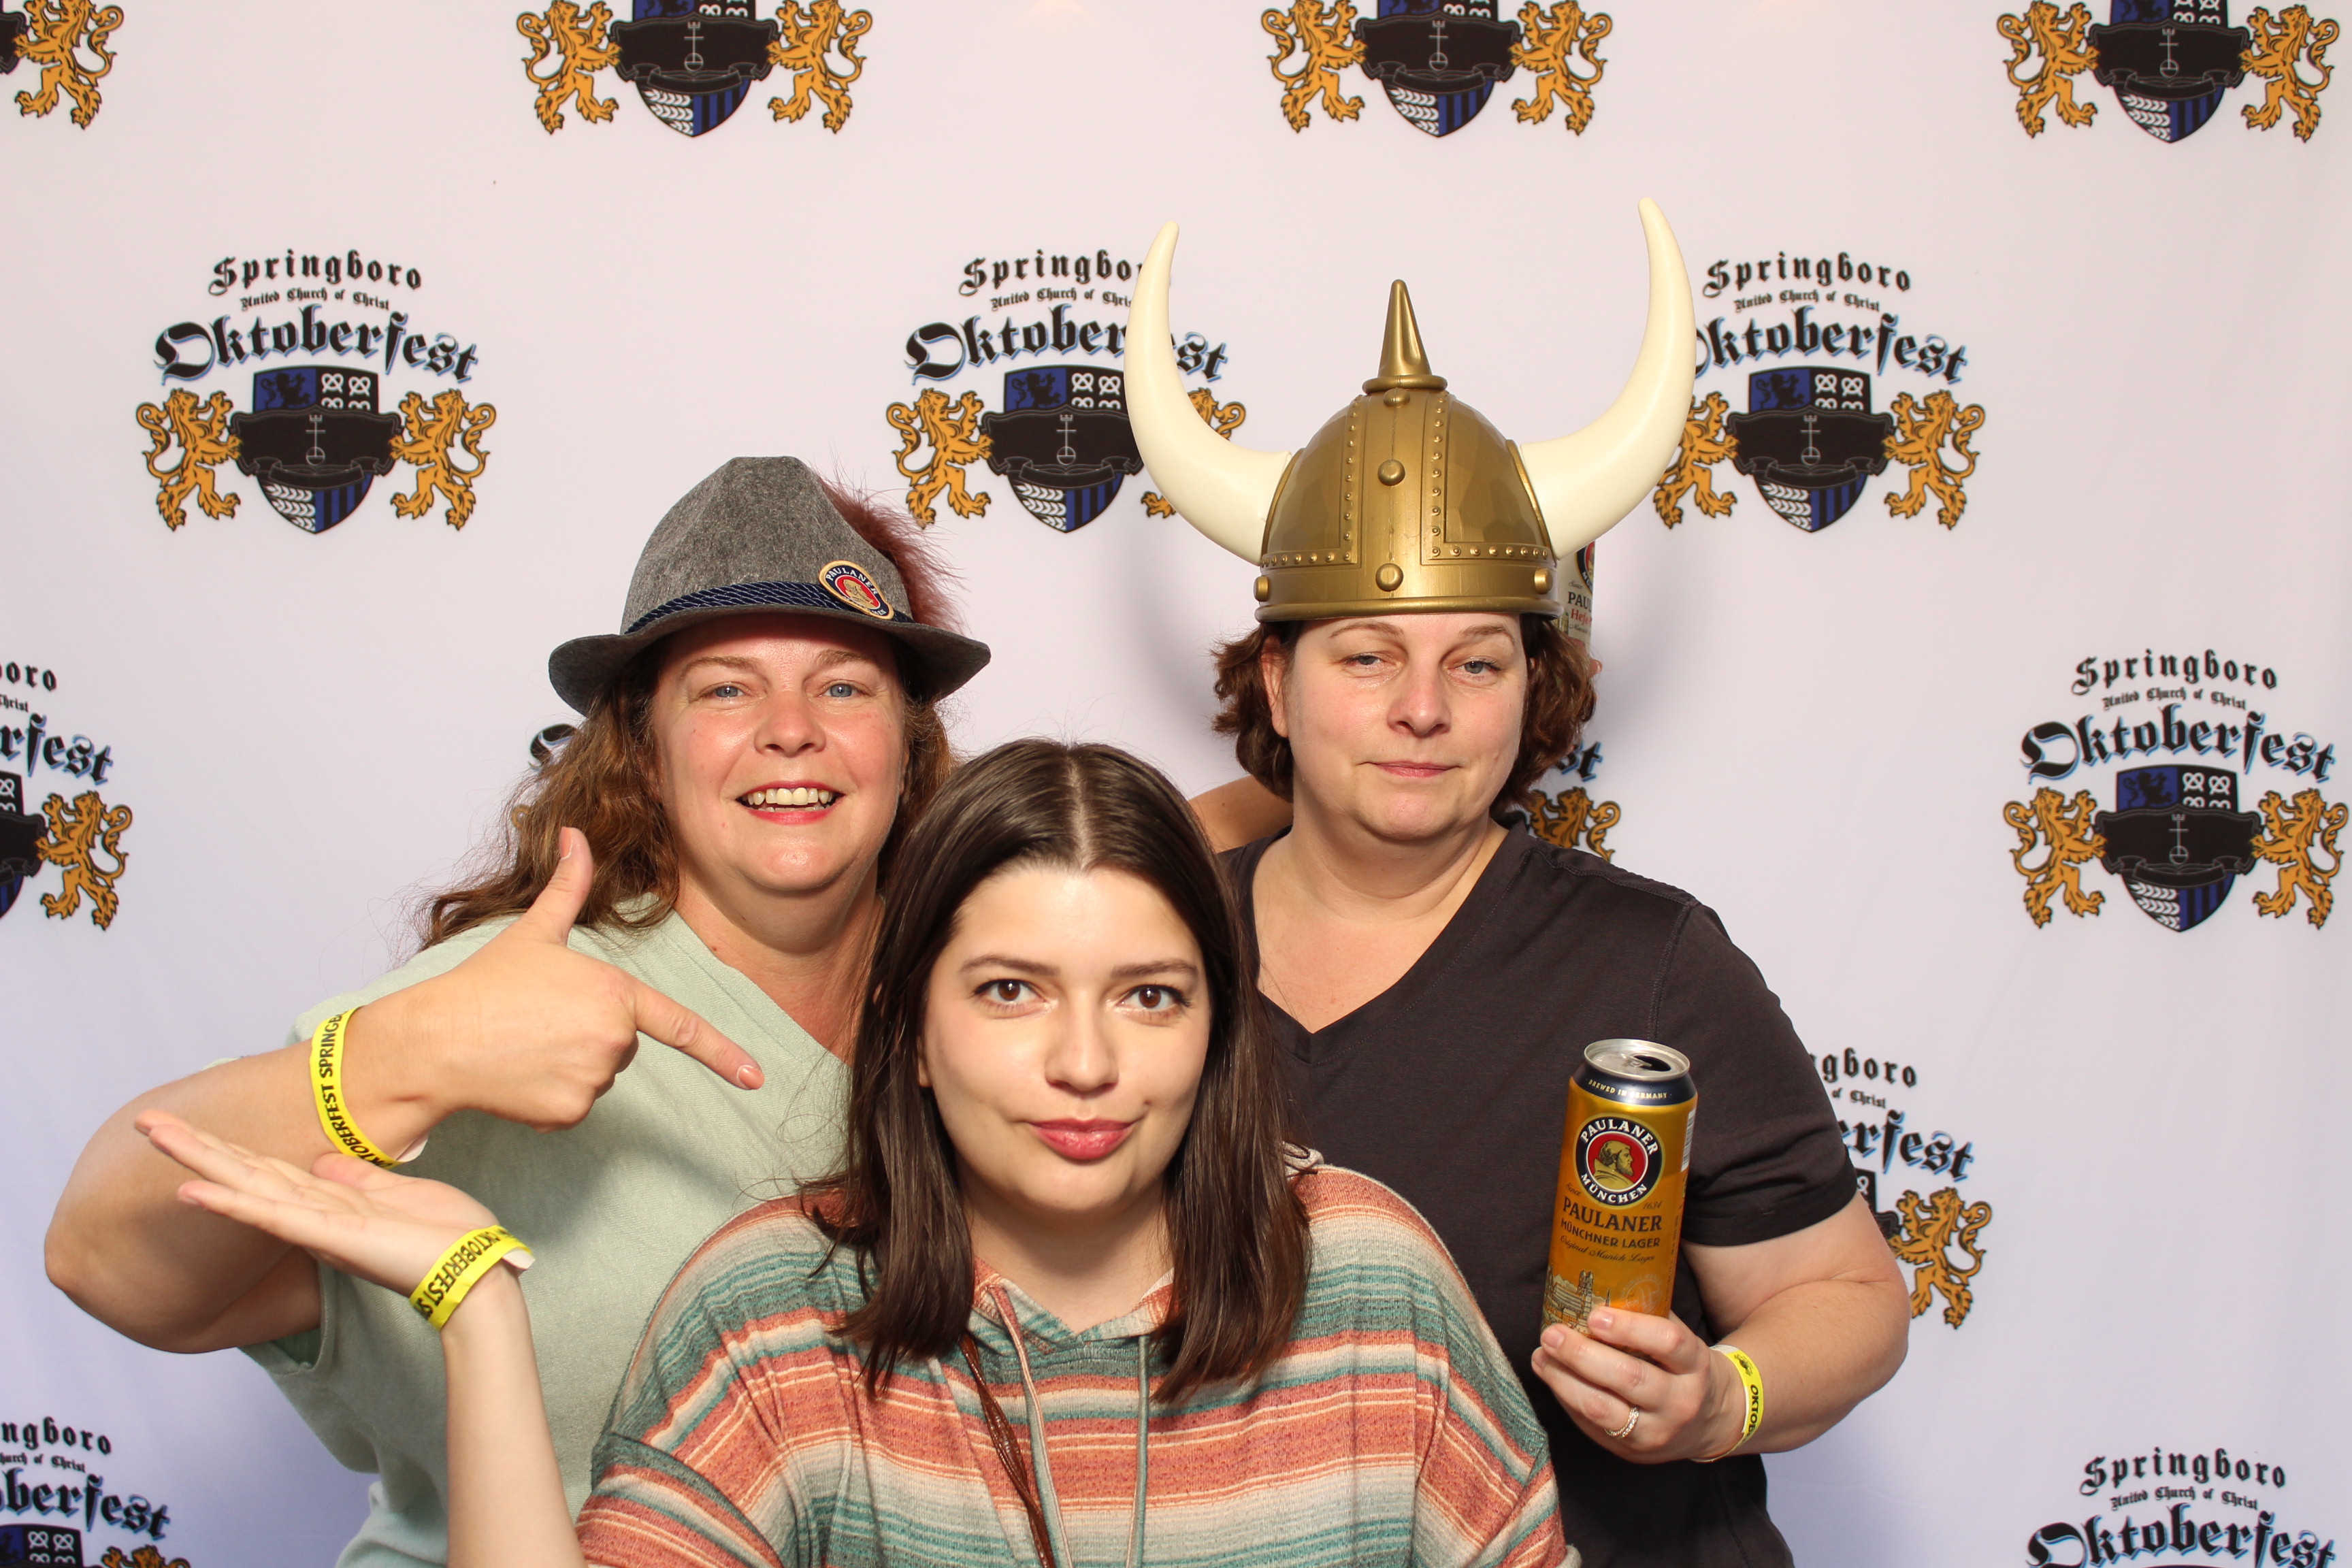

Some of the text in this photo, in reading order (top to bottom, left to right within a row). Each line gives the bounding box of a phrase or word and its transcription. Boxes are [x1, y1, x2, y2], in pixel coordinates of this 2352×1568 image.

[208, 249, 422, 295] Springboro
[958, 249, 1143, 295] Springbo
[1702, 251, 1911, 298] Springboro
[240, 287, 389, 311] United Church of Christ
[990, 290, 1030, 312] United
[1036, 287, 1077, 301] Church
[1084, 289, 1094, 300] of
[1734, 289, 1880, 313] United Church of Christ
[153, 304, 478, 385] Oktoberfest
[904, 304, 1228, 385] Oktoberst
[1696, 305, 1967, 385] ktoberfest
[826, 567, 879, 595] PAULANER
[2072, 649, 2277, 695] Springboro
[2102, 687, 2247, 711] United Church of Christ
[2020, 704, 2335, 784] Oktoberfest
[1588, 1079, 1616, 1094] BREWED
[1618, 1089, 1627, 1097] IN
[1832, 1088, 1886, 1109] of Christ
[1581, 1119, 1659, 1154] PAULANER
[1581, 1173, 1648, 1203] MÜNCHEN
[1563, 1196, 1663, 1232] PAULANER
[1642, 1200, 1663, 1210] 1634
[1561, 1218, 1661, 1248] MÜNCHNER LAGER
[1561, 1235, 1656, 1264] Original Munich Lager
[34, 1454, 44, 1464] of
[51, 1455, 86, 1473] Christ
[2079, 1447, 2285, 1496] Springboro
[0, 1467, 170, 1541] berfest
[2110, 1486, 2259, 1511] United Church of Christ
